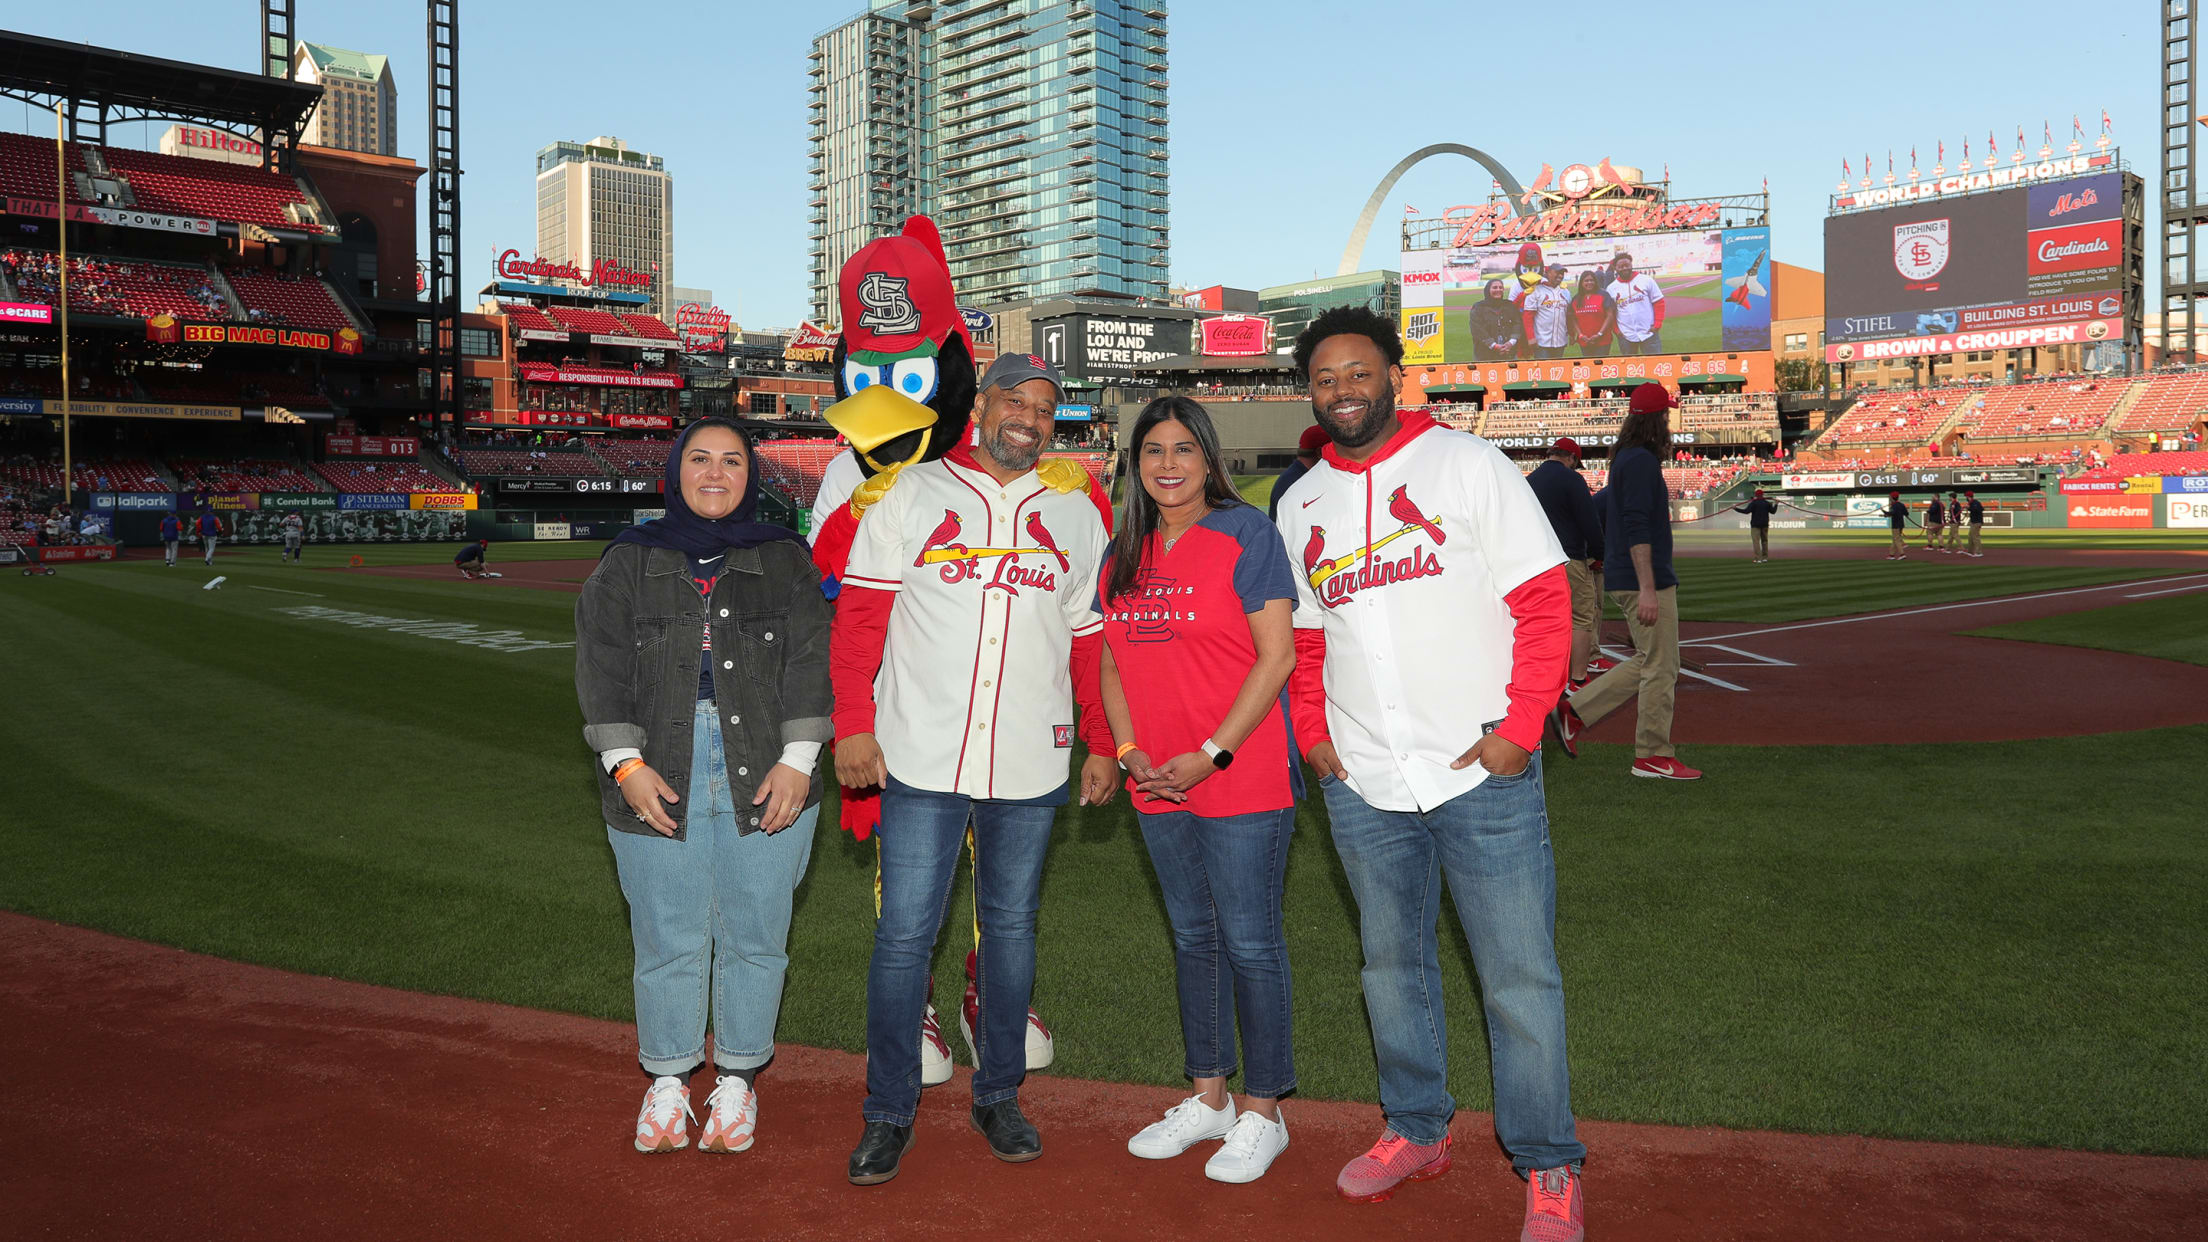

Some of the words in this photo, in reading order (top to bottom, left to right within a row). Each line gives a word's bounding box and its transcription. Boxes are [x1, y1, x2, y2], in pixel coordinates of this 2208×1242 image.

[179, 128, 262, 155] Hilton
[1852, 181, 1935, 208] WORLD
[1939, 157, 2090, 193] CHAMPIONS
[2048, 188, 2098, 217] Mets
[74, 207, 84, 219] A
[119, 213, 192, 230] POWER
[1442, 195, 1721, 248] Budweiser
[1896, 222, 1938, 236] PITCHING
[2038, 237, 2110, 262] Cardinals
[499, 249, 582, 280] Cardinals
[581, 258, 650, 287] Nation
[1403, 272, 1440, 283] KMOX
[1293, 285, 1333, 297] POLSINELLI
[16, 308, 48, 319] CARE
[675, 303, 732, 333] Bally
[1964, 307, 2026, 323] BUILDING
[2029, 305, 2048, 317] ST.
[2052, 300, 2093, 314] LOUIS
[1410, 312, 1436, 327] HOT
[1844, 316, 1896, 335] STIFEL
[688, 326, 718, 337] SPORTS
[1087, 320, 1126, 334] FROM
[1129, 322, 1154, 336] THE
[1406, 322, 1441, 340] SHOT
[184, 325, 225, 342] BIG
[228, 326, 276, 344] MAC
[279, 330, 330, 350] LAND
[1087, 334, 1114, 347] LOU
[1117, 336, 1146, 349] AND
[1863, 338, 1936, 358] BROWN
[1940, 340, 1952, 351] &
[1956, 326, 2076, 350] CROUPPEN
[785, 348, 827, 362] BREW
[1087, 348, 1131, 362] WE'RE
[1443, 372, 1449, 384] 1
[1456, 371, 1464, 384] 2
[1472, 371, 1481, 383] 6
[1488, 370, 1497, 382] 9
[1506, 369, 1519, 382] 10
[1528, 367, 1542, 381] 14
[1550, 366, 1564, 381] 17
[1572, 366, 1590, 380] 20
[1601, 365, 1619, 378] 23
[1626, 363, 1645, 377] 24
[1654, 362, 1673, 376] 42
[1682, 361, 1701, 375] 45
[1707, 360, 1726, 374] 85
[559, 372, 614, 384] RESPONSIBILITY
[615, 374, 630, 385] HAS
[631, 375, 642, 385] ITS
[643, 376, 676, 387] REWARDS.
[54, 403, 106, 413] FLXIBILITY
[116, 406, 175, 416] CONVENIENCE
[184, 408, 233, 417] EXPERIENCE
[1489, 437, 1544, 448] WORLD
[1803, 474, 1849, 483] Schnucks
[1876, 474, 1897, 483] 6:15
[1961, 473, 1981, 483] Mercy
[508, 482, 526, 491] Mercy
[591, 481, 611, 490] 6:15
[2091, 482, 2116, 490] RENTS
[277, 497, 309, 506] Central
[312, 497, 335, 506] Bank
[357, 495, 405, 503] SITEMAN
[424, 496, 465, 505] DOBBS
[939, 543, 982, 585] St.
[983, 551, 1057, 597] Louis
[1318, 545, 1445, 609] Cardinals
[1146, 586, 1194, 596] LOUIS
[1104, 611, 1195, 622] CARDINALS
